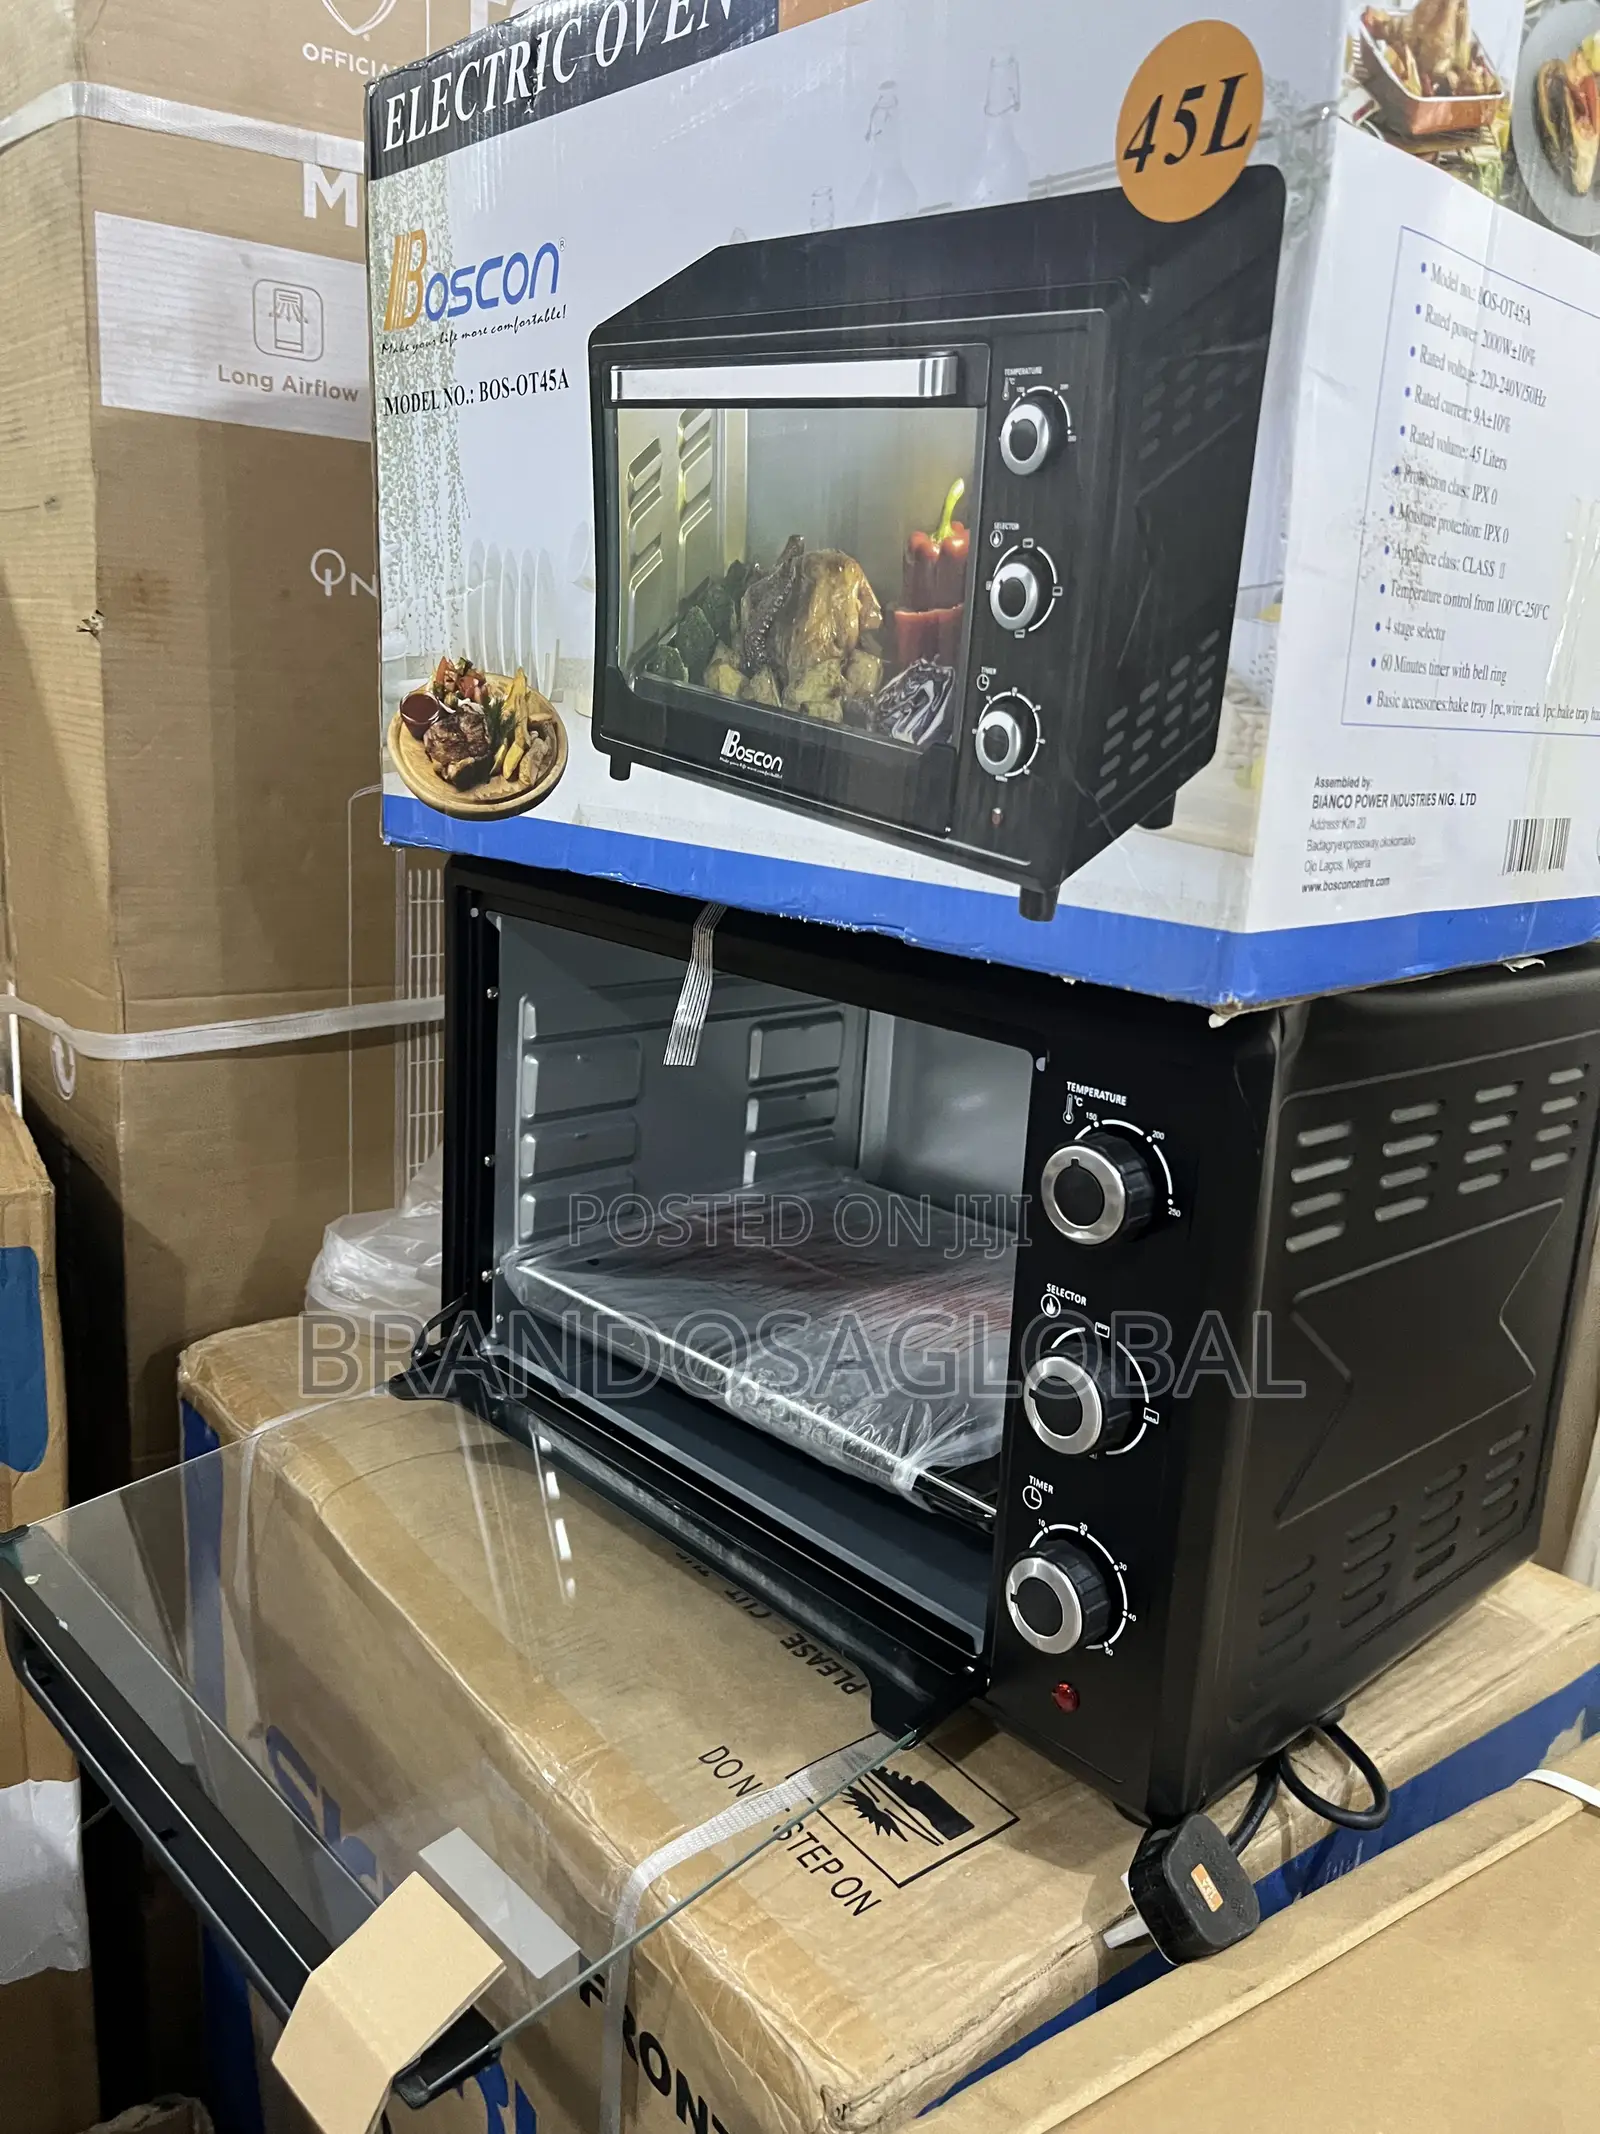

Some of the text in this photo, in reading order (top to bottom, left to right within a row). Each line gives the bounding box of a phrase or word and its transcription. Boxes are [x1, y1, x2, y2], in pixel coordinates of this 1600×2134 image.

[302, 42, 397, 80] OFFICIA
[383, 18, 582, 152] ELECTRIC
[1123, 73, 1252, 173] 45L
[1431, 262, 1459, 292] Model
[381, 341, 410, 355] Make
[440, 330, 458, 347] life
[461, 328, 487, 340] more
[491, 304, 567, 334] comfortable!
[1425, 304, 1451, 331] Rated
[1420, 344, 1446, 371] Rated
[218, 364, 359, 402] Long Airflow
[384, 390, 440, 416] MODEL
[479, 368, 570, 402] BOS-OT45A
[1414, 384, 1440, 410] Rated
[1410, 424, 1435, 449] Rated
[1469, 445, 1482, 463] 45
[1483, 448, 1507, 471] Liters
[1472, 484, 1490, 504] IPX
[1484, 524, 1501, 543] IPX
[1462, 556, 1496, 577] CLASS
[1443, 593, 1473, 610] control
[1474, 593, 1495, 612] from
[1497, 597, 1550, 620] 100°C-250°C
[1385, 616, 1391, 633] 4
[1393, 621, 1414, 641] stage
[1381, 653, 1393, 672] 60
[1394, 654, 1427, 675] Minutes
[1452, 661, 1471, 679] with
[1473, 664, 1488, 681] bell
[1490, 666, 1507, 686] ring
[1377, 690, 1400, 708] Basic
[1470, 700, 1487, 718] tray
[1524, 702, 1540, 717] rack
[1575, 707, 1589, 724] tray
[1314, 776, 1373, 791] Assembled by:
[1312, 792, 1478, 809] BIANCO POWER INDUSTRIES NIG. LTD
[1356, 817, 1366, 830] 20
[1346, 858, 1371, 873] Nigeria
[1066, 1081, 1127, 1106] TEMPERATURE
[1086, 1111, 1098, 1122] 150
[1152, 1129, 1165, 1140] 200
[1167, 1207, 1181, 1218] 250
[1046, 1283, 1087, 1306] SELECTOR
[1029, 1475, 1054, 1495] TIMER
[1038, 1518, 1046, 1527] 10
[1079, 1522, 1088, 1531] 20
[1128, 1613, 1137, 1622] 40
[780, 1632, 868, 1695] PLEASE
[830, 1876, 882, 1916] ON
